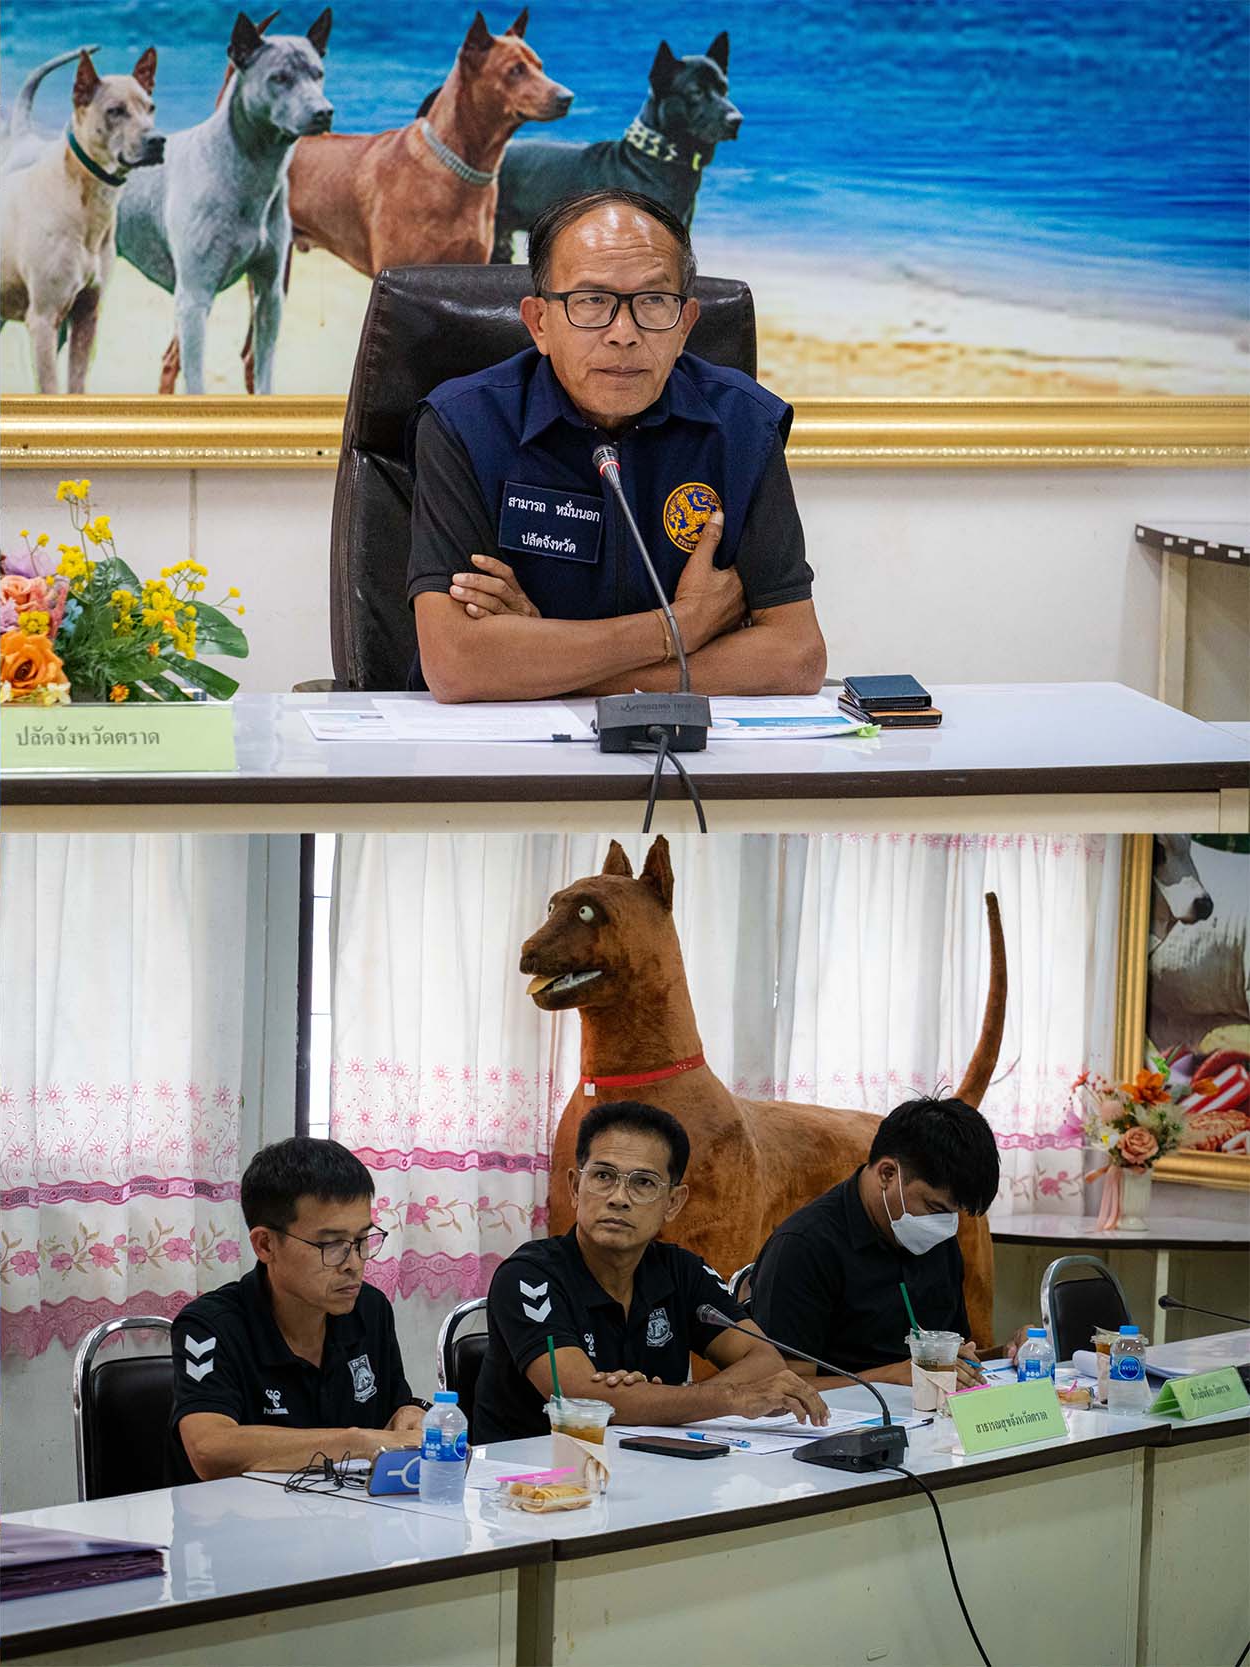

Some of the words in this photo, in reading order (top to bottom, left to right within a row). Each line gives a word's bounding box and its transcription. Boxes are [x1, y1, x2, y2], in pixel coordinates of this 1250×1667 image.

[508, 496, 547, 513] สามารถ
[521, 532, 577, 553] ปลัดจังหวัด
[16, 725, 160, 746] ปลัดจังหวัดตราด
